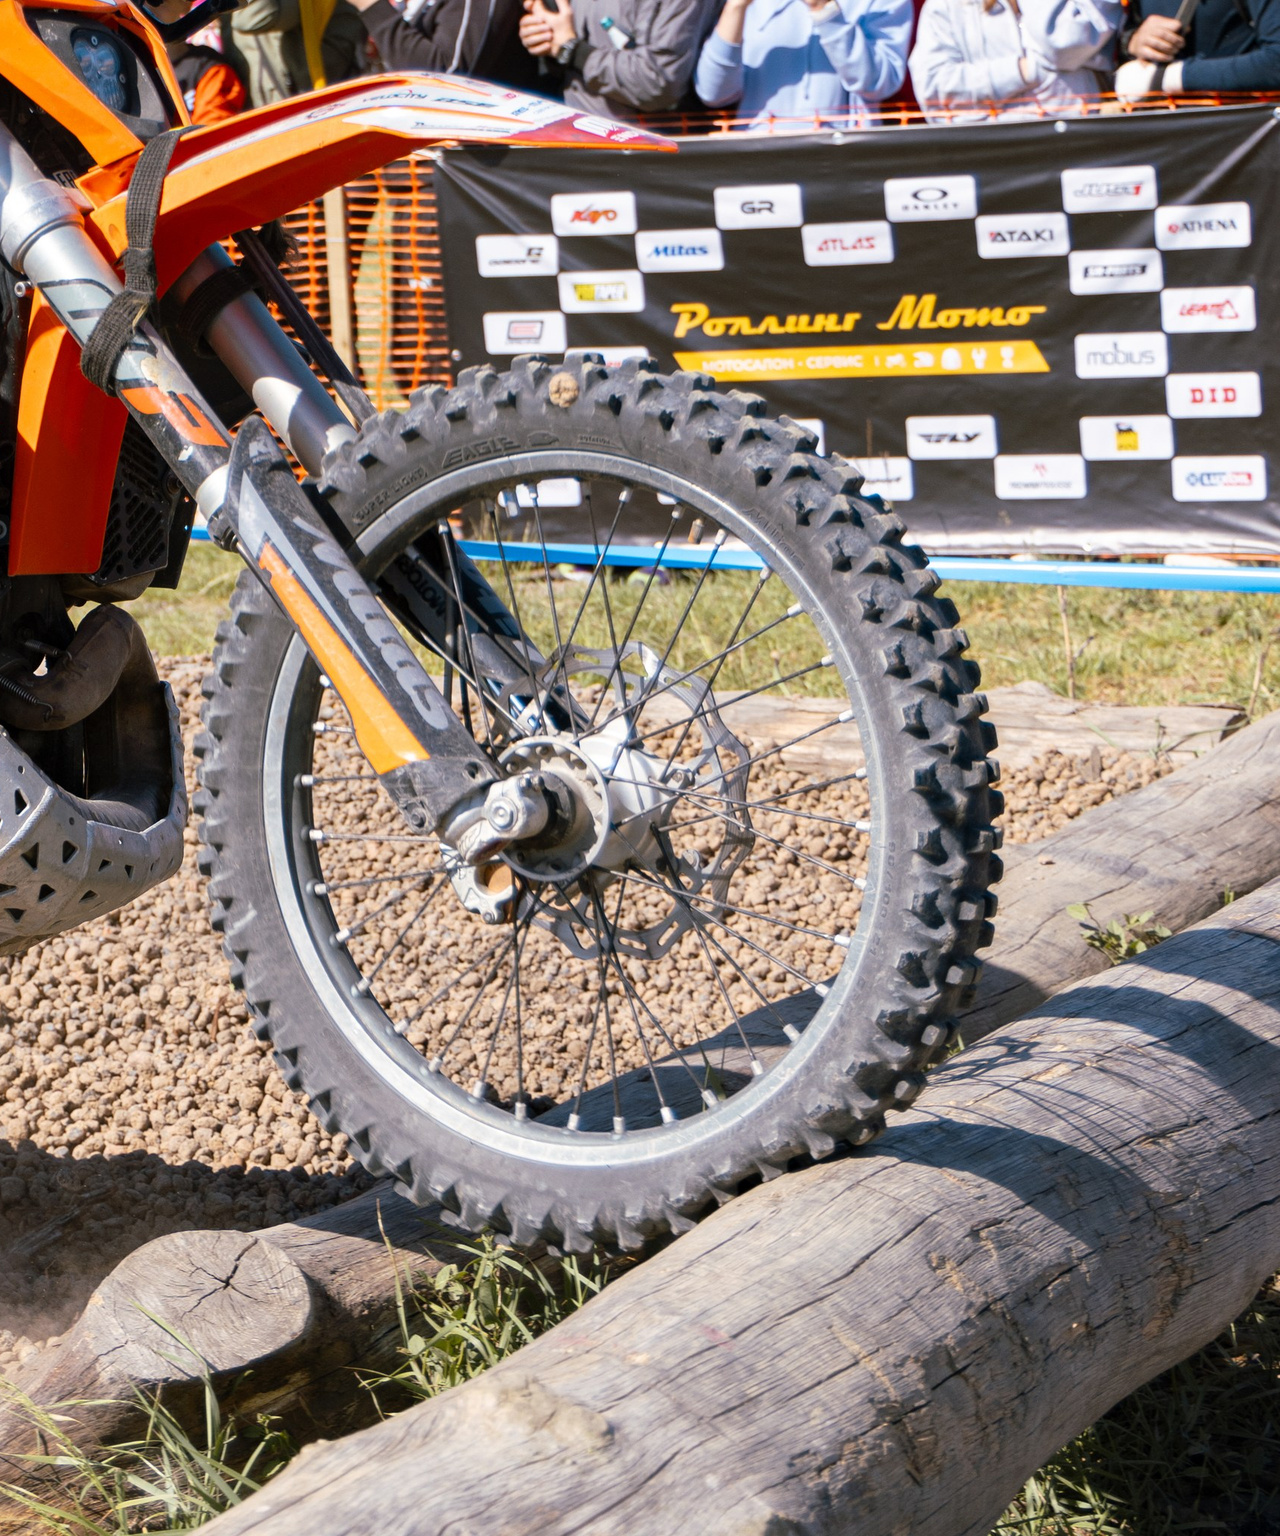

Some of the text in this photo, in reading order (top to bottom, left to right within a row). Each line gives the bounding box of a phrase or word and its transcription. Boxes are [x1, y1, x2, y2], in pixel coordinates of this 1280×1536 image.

[1179, 218, 1238, 232] ATHENA
[989, 229, 1055, 243] ATAKI
[646, 244, 709, 258] Mitas
[817, 236, 876, 252] ATLAS
